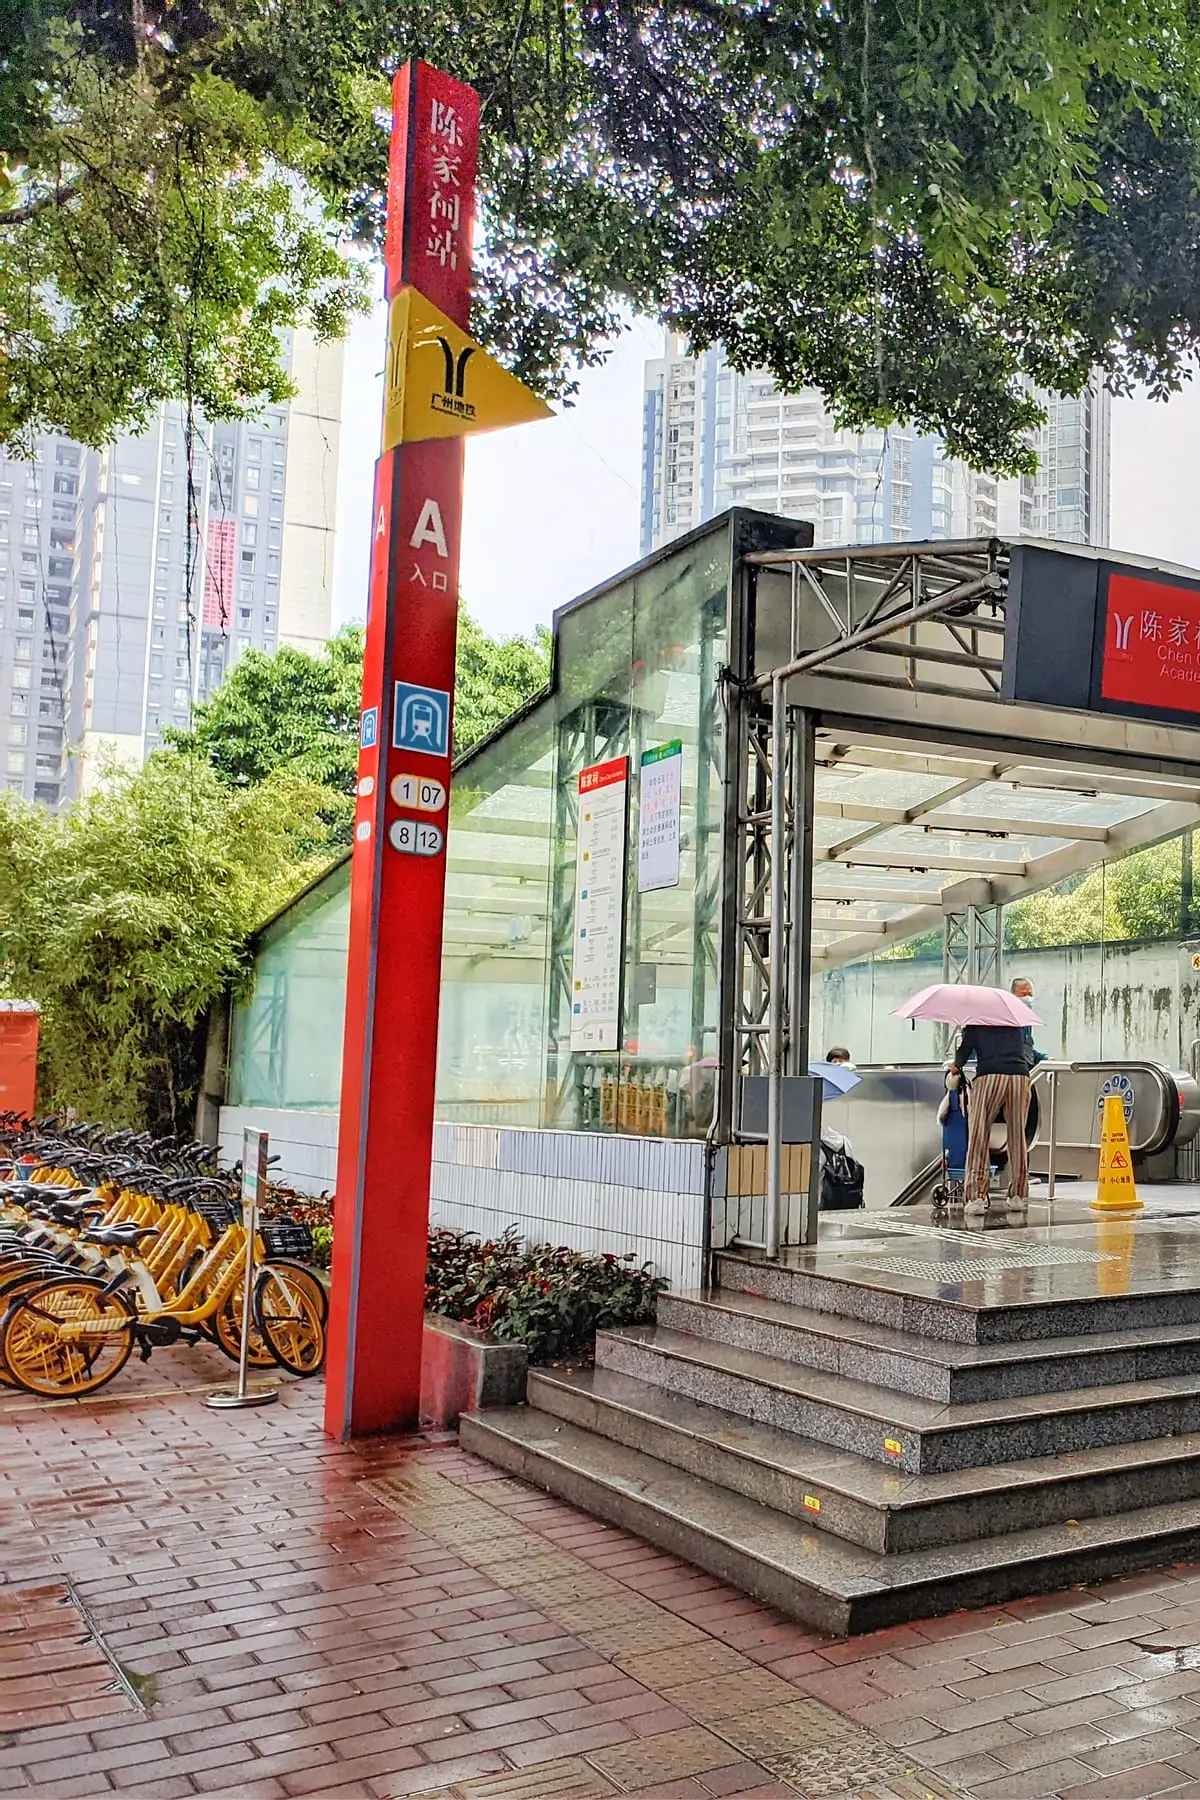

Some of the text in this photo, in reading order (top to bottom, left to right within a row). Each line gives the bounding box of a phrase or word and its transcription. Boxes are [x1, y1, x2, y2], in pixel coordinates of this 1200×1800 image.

[410, 498, 449, 558] A
[410, 562, 448, 592] 入口
[1157, 645, 1192, 664] Chen
[402, 782, 441, 806] 1 07
[399, 827, 438, 850] 8 12
